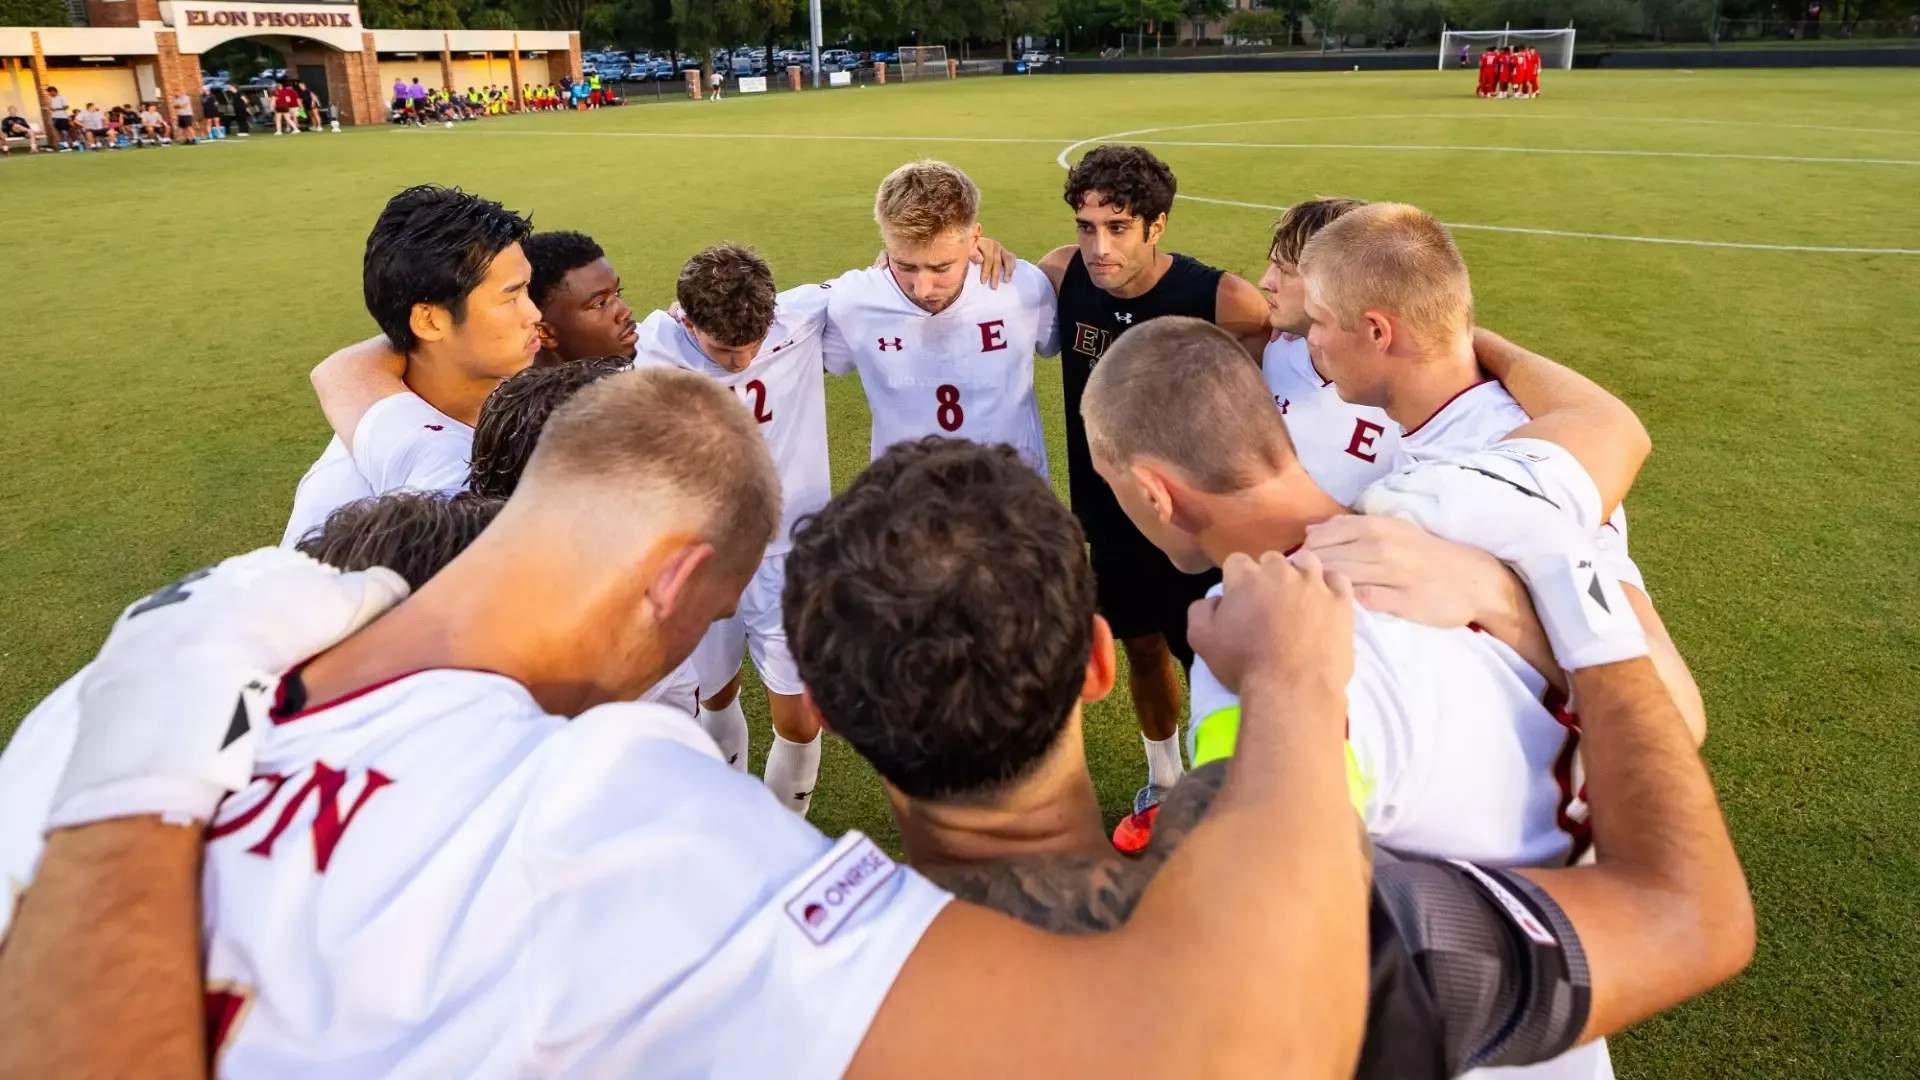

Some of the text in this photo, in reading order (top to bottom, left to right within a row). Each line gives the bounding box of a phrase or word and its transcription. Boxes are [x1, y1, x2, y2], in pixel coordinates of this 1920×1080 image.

[185, 10, 352, 28] ELON PHOENIX
[976, 319, 1008, 353] E
[936, 384, 964, 432] 8
[1344, 417, 1386, 464] E
